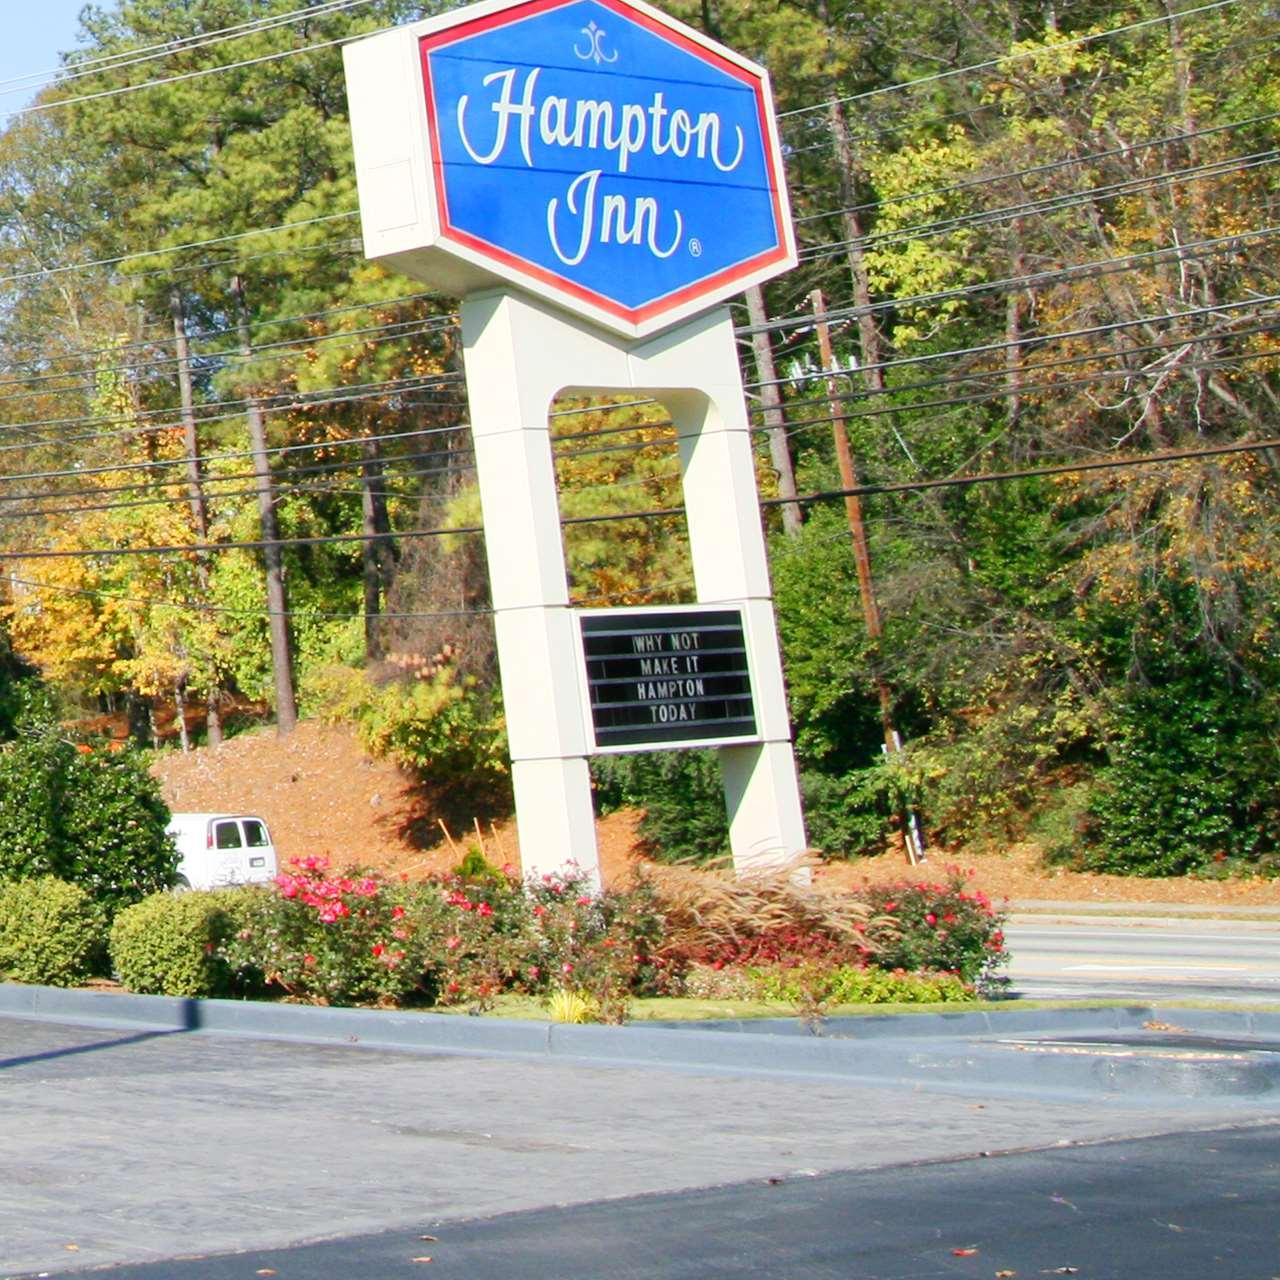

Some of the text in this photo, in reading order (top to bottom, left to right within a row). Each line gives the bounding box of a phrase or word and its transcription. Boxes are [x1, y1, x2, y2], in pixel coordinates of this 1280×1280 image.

[457, 66, 744, 173] Hampton
[547, 169, 682, 266] Inn
[632, 632, 699, 655] WHY NOT
[640, 655, 700, 676] MAKE IT
[637, 679, 705, 700] HAMPTON
[650, 703, 697, 723] TODAY
